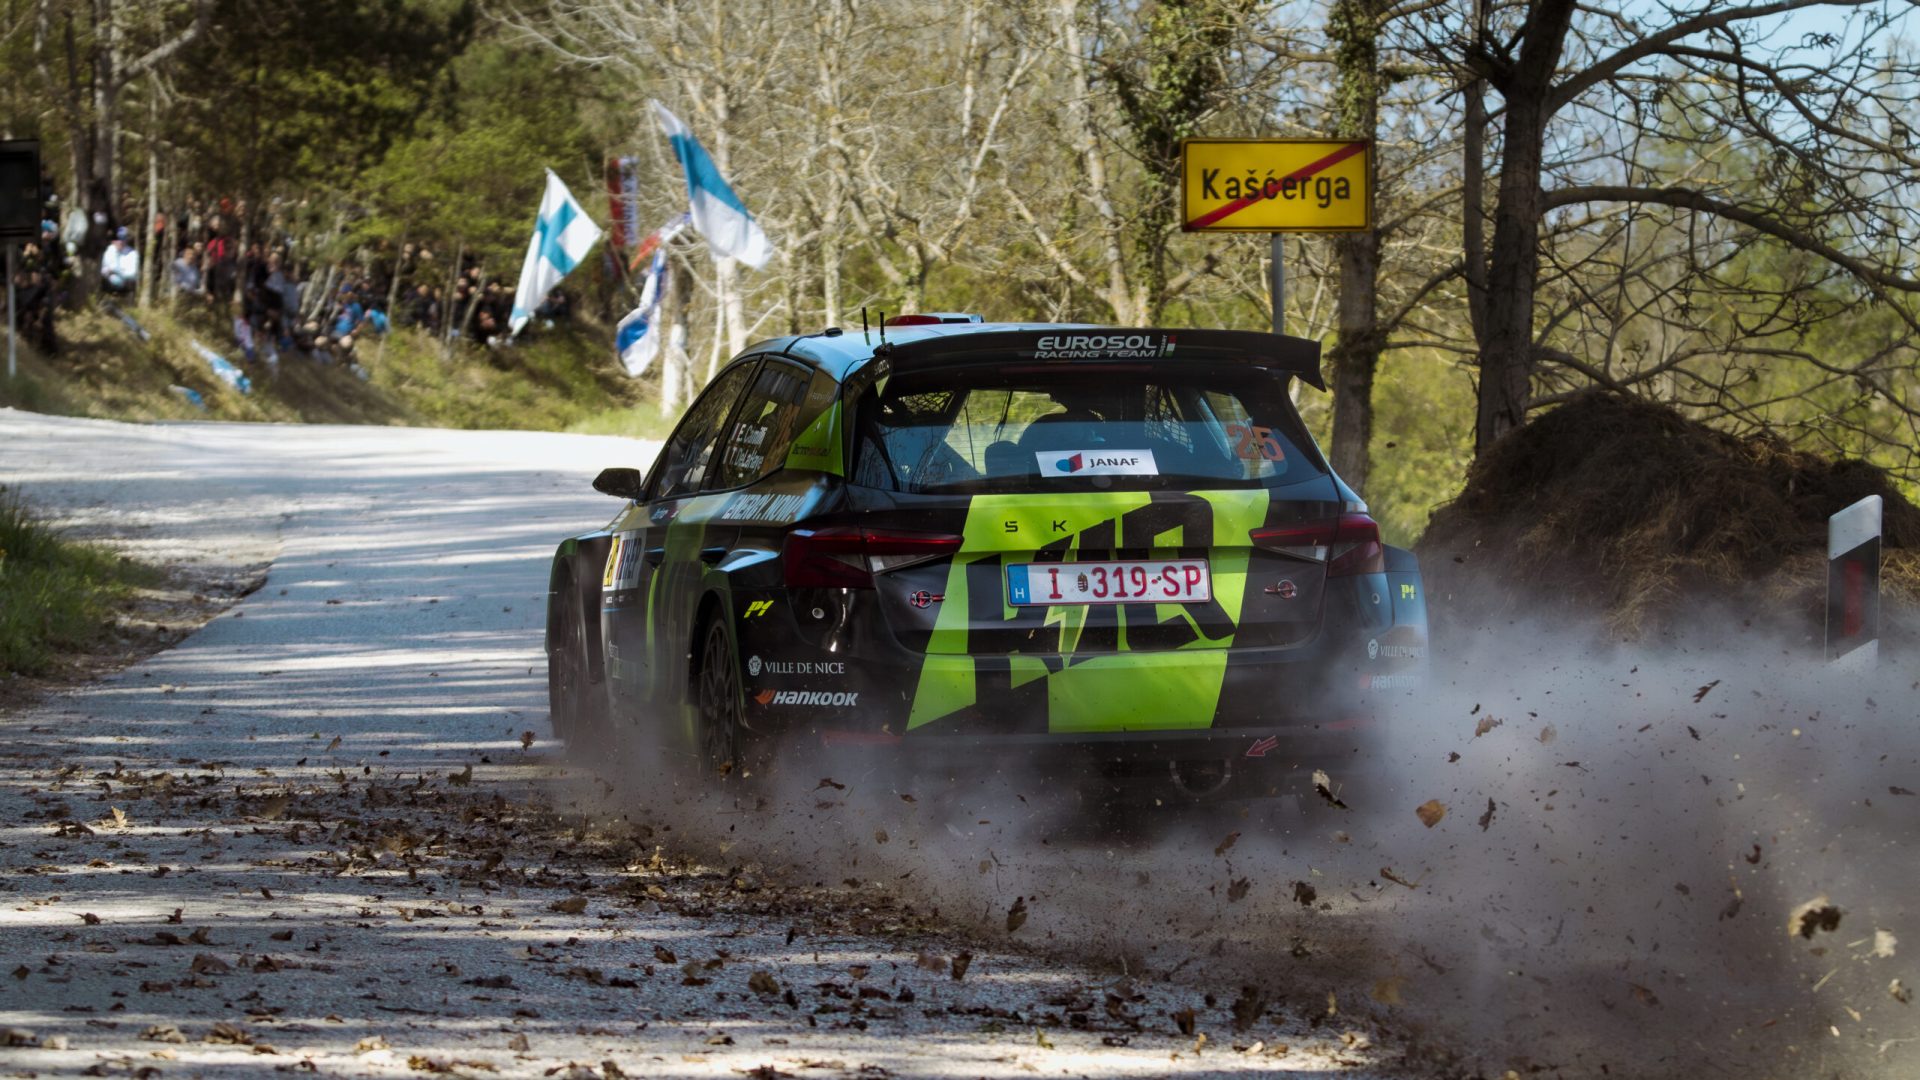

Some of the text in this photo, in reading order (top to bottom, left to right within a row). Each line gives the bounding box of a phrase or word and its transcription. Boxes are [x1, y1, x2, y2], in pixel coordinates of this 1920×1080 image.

[1202, 168, 1350, 208] Kašćerga
[1037, 335, 1157, 350] EUROSOL
[1034, 350, 1156, 359] RACING TEAM
[1089, 458, 1139, 468] JANAF
[1015, 587, 1025, 599] H
[765, 662, 845, 674] VILLE DE NICE
